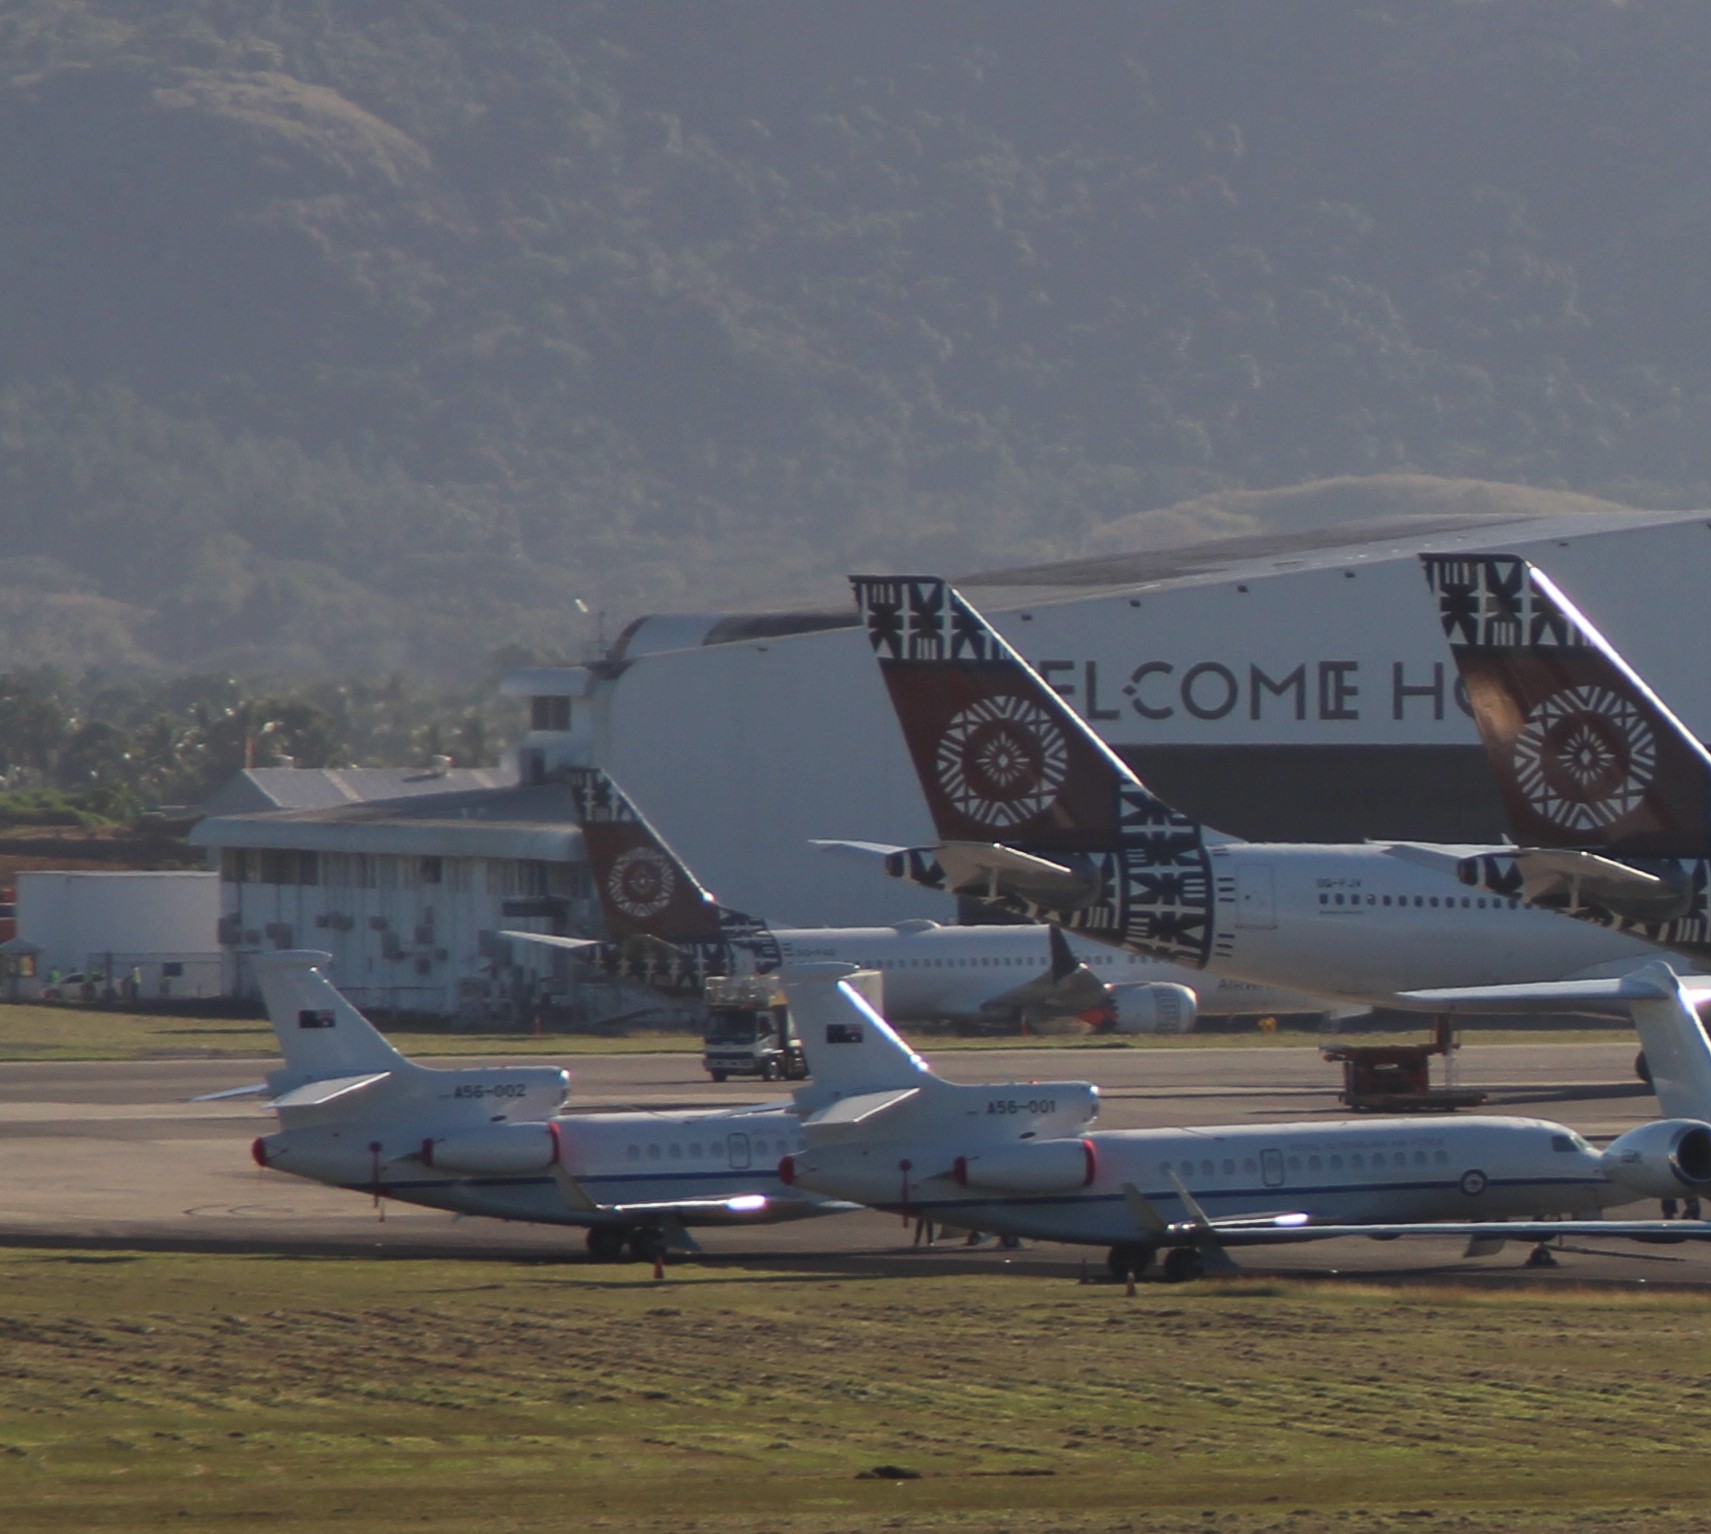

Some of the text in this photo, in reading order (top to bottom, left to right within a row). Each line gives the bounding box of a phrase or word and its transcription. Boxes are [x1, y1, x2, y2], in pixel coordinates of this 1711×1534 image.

[1038, 660, 1359, 720] ELCOME
[454, 1083, 527, 1099] A56-002
[986, 1099, 1057, 1115] A56-001
